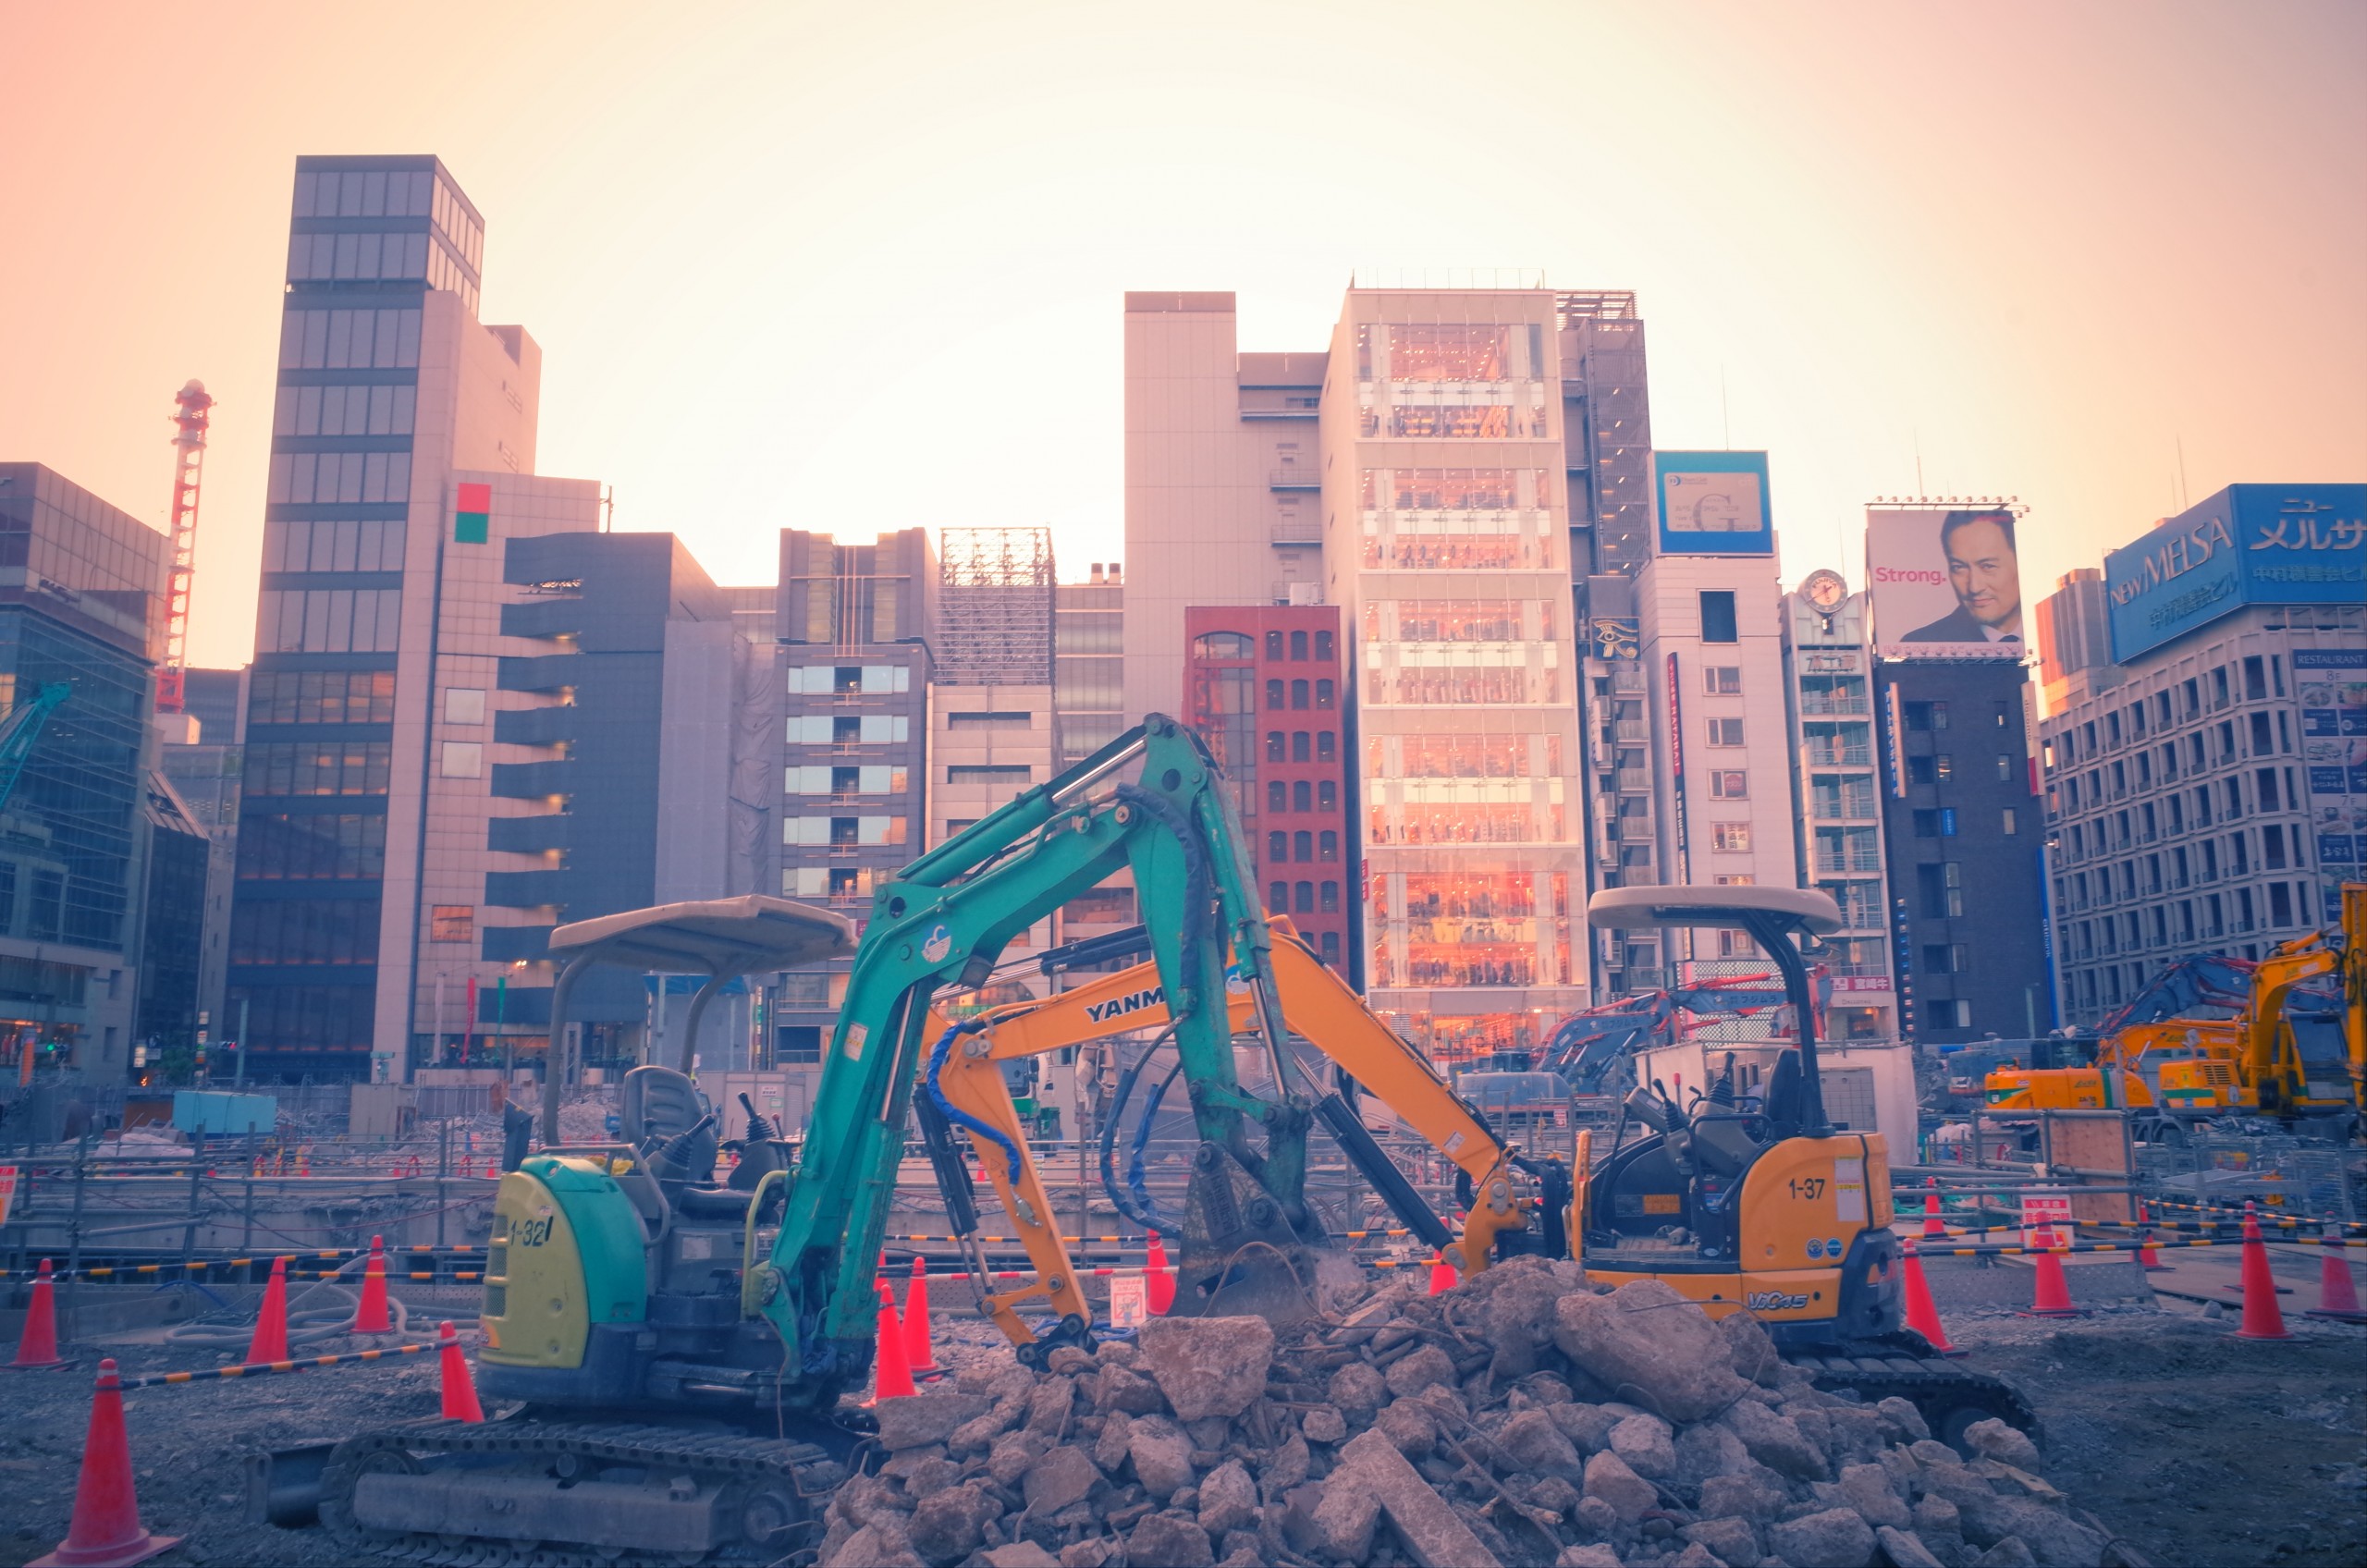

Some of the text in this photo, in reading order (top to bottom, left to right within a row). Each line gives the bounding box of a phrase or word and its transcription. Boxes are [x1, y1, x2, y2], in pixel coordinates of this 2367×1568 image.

[2279, 497, 2335, 513] ニュー
[2249, 518, 2367, 550] メルサ
[2110, 516, 2234, 610] NEW MELSA
[1875, 567, 1947, 586] Strong.
[2298, 655, 2364, 664] RESTAURANT
[2024, 699, 2032, 741] docomo
[1788, 1178, 1825, 1199] 1-37
[510, 1219, 546, 1247] 1-32
